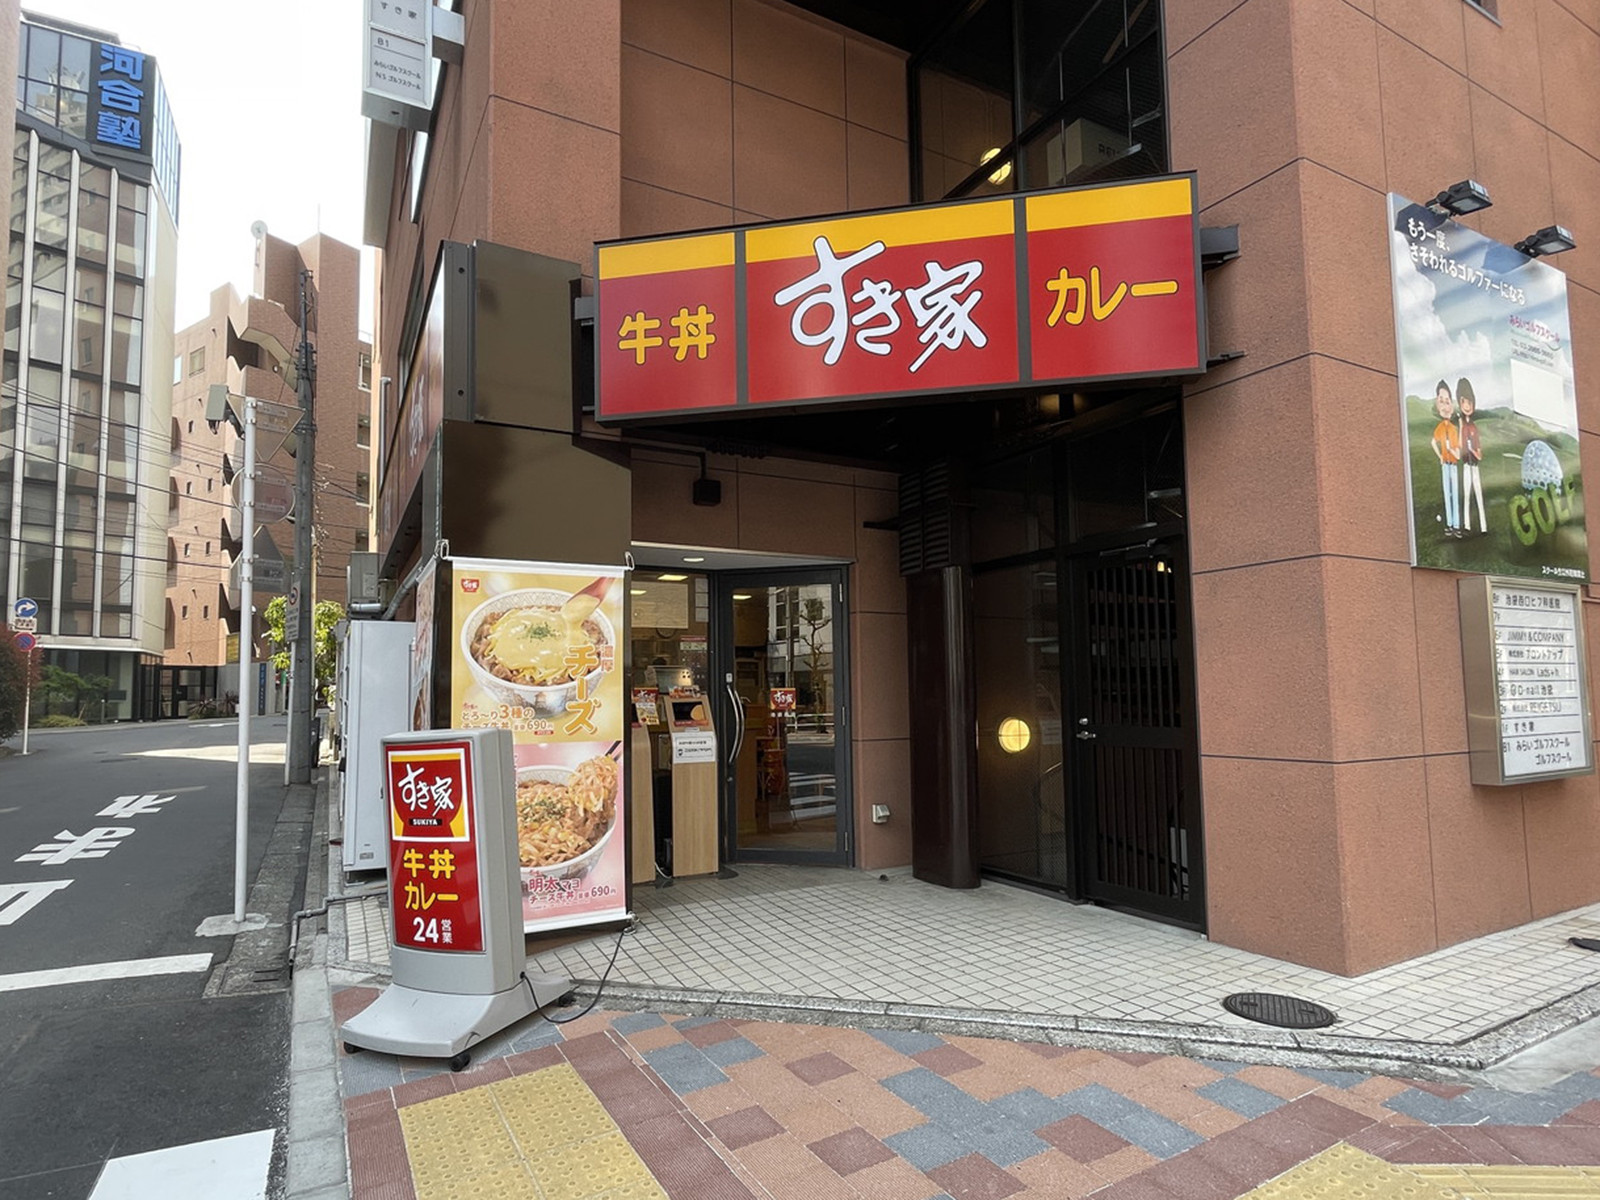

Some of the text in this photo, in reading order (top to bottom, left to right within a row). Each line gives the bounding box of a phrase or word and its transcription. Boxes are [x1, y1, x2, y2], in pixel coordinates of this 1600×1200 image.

[97, 43, 145, 150] 河合塾
[774, 235, 988, 373] すき家
[1045, 265, 1179, 328] カレー
[1409, 242, 1526, 305] さそわれるゴルファーになる
[617, 303, 717, 365] 牛丼
[1508, 477, 1576, 546] GOLF
[563, 644, 601, 734] チーズ
[398, 763, 455, 816] すき家
[412, 818, 438, 826] SUKIYA
[403, 848, 457, 880] 牛丼
[404, 880, 459, 911] カレー
